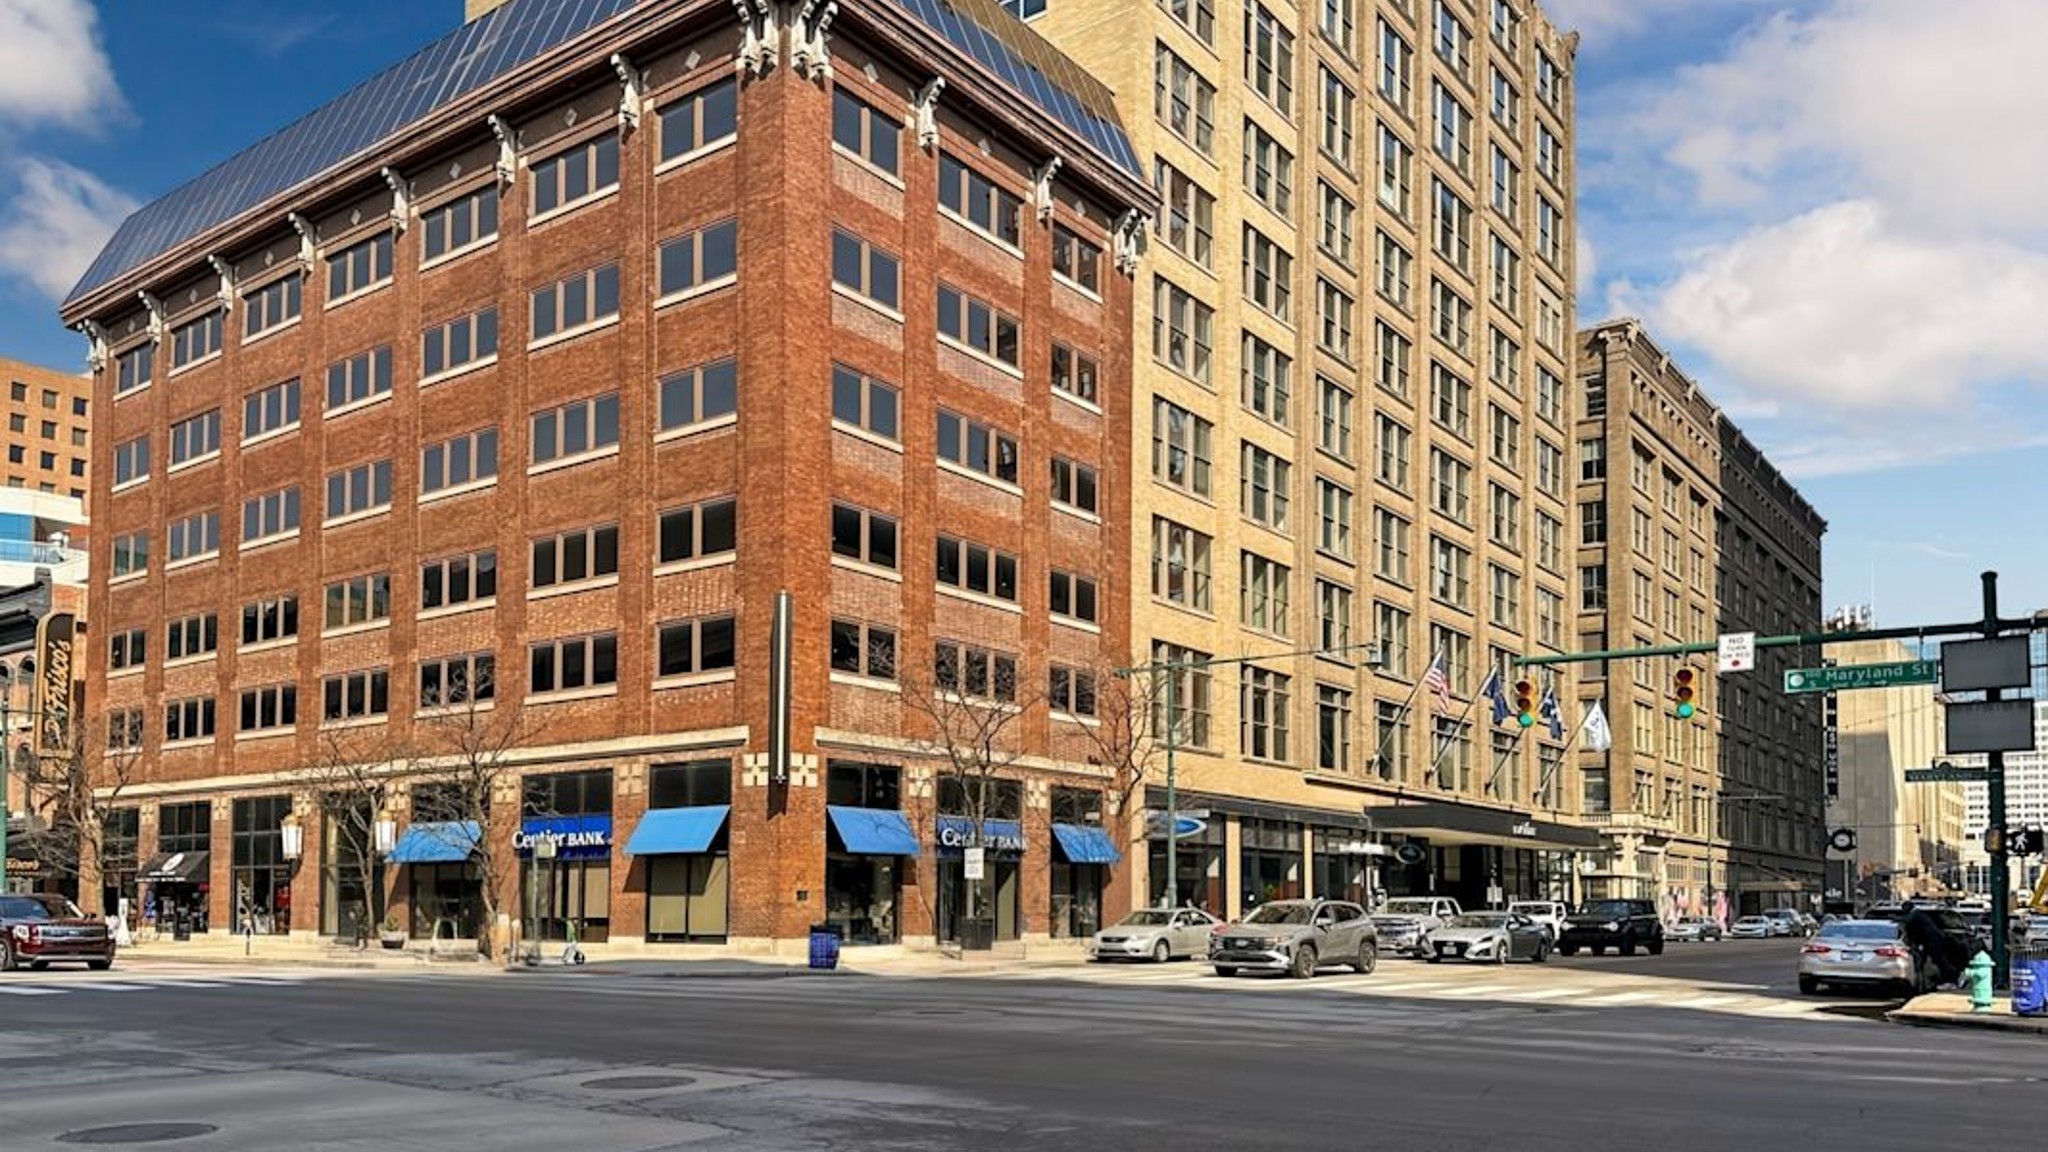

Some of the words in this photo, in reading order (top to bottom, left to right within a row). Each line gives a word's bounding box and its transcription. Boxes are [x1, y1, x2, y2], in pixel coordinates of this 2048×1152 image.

[1728, 637, 1745, 645] NO
[1826, 665, 1904, 681] Maryland
[1911, 663, 1929, 677] St
[568, 831, 605, 847] BANK
[941, 827, 993, 848] Center
